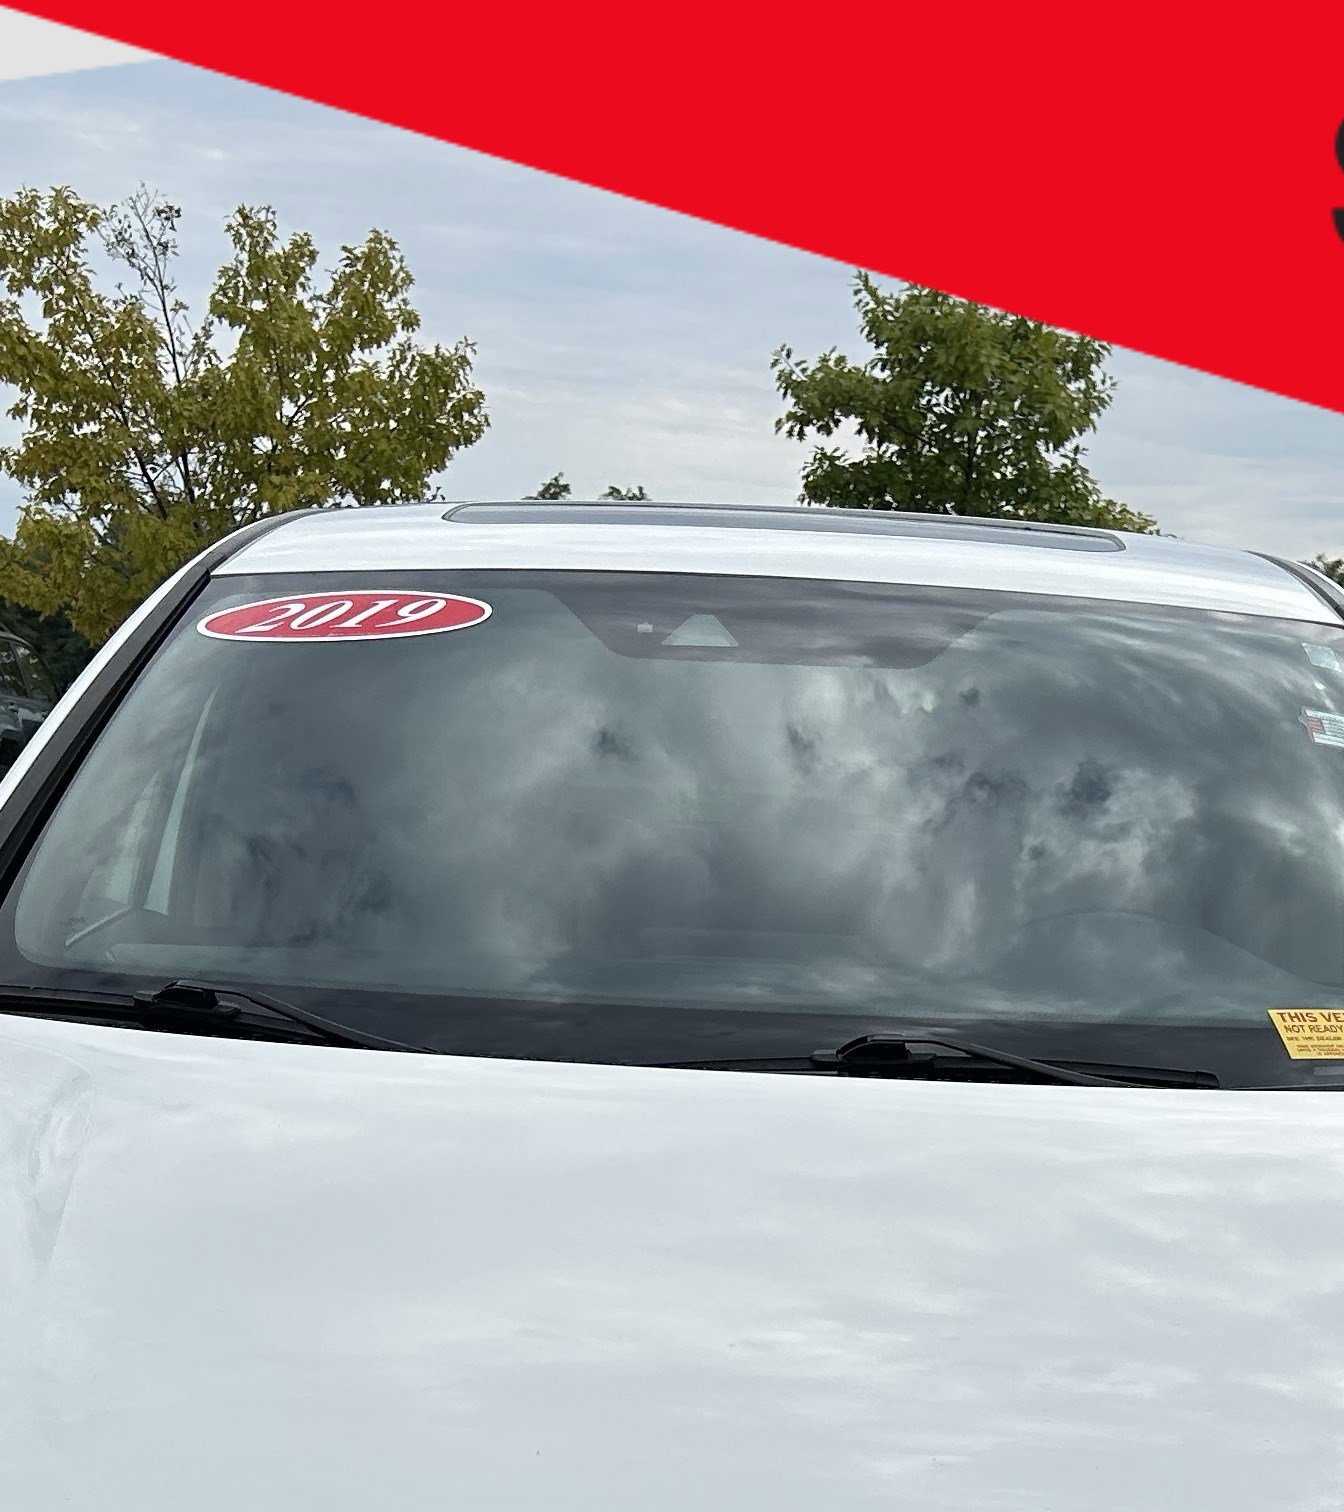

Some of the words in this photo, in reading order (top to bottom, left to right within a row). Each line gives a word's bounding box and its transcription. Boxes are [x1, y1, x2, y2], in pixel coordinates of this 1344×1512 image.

[235, 599, 447, 633] 2019
[1276, 1012, 1318, 1023] THIS
[1284, 1025, 1307, 1034] NOT
[1308, 1025, 1344, 1034] READY
